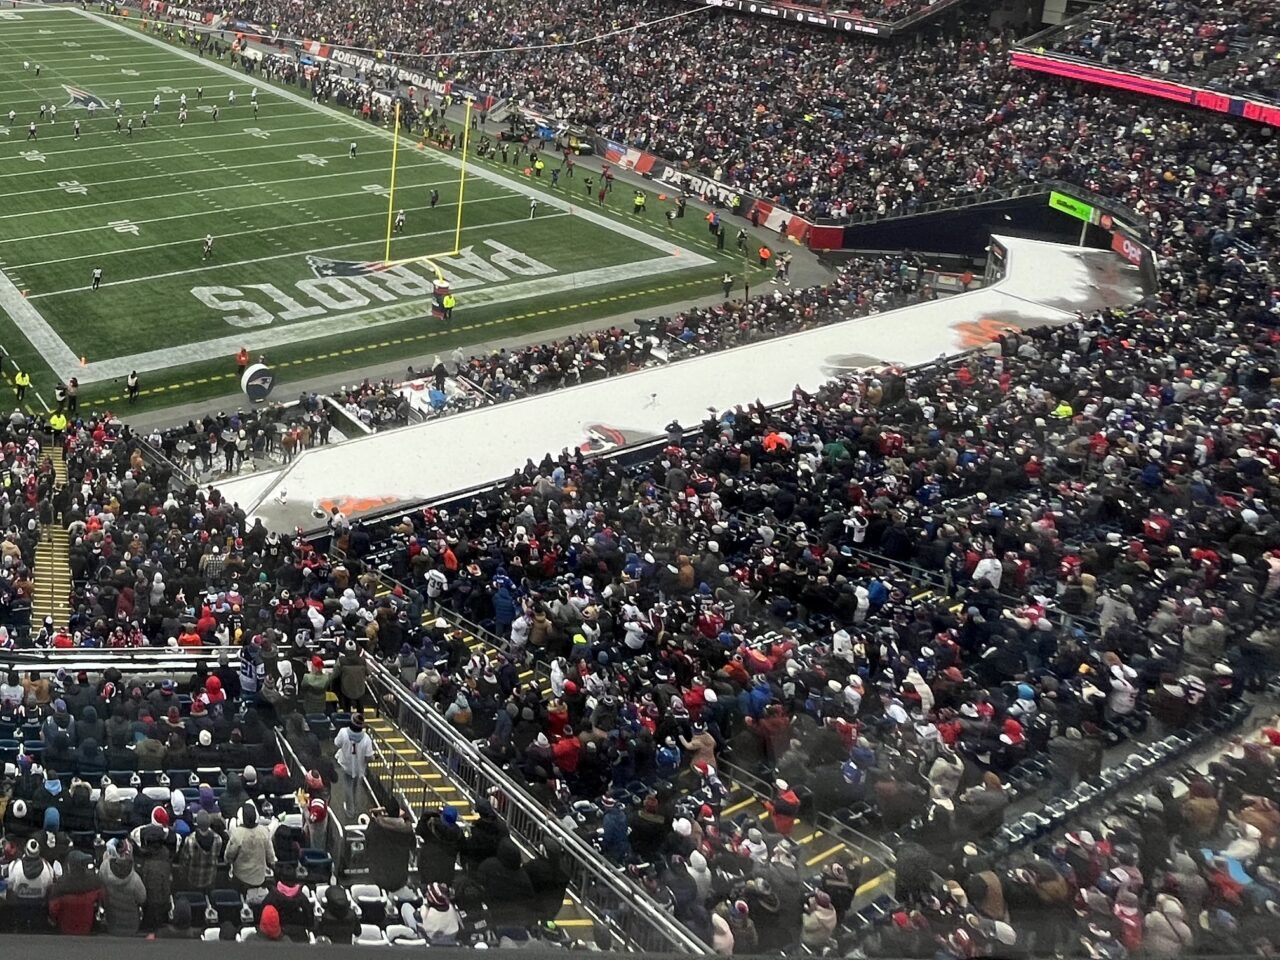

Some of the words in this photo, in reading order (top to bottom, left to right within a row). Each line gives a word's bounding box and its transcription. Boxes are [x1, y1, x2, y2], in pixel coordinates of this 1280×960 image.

[332, 49, 374, 72] FOREVER
[398, 69, 446, 93] ENGLAND
[190, 239, 557, 328] PATRIOTS
[350, 743, 357, 755] 1
